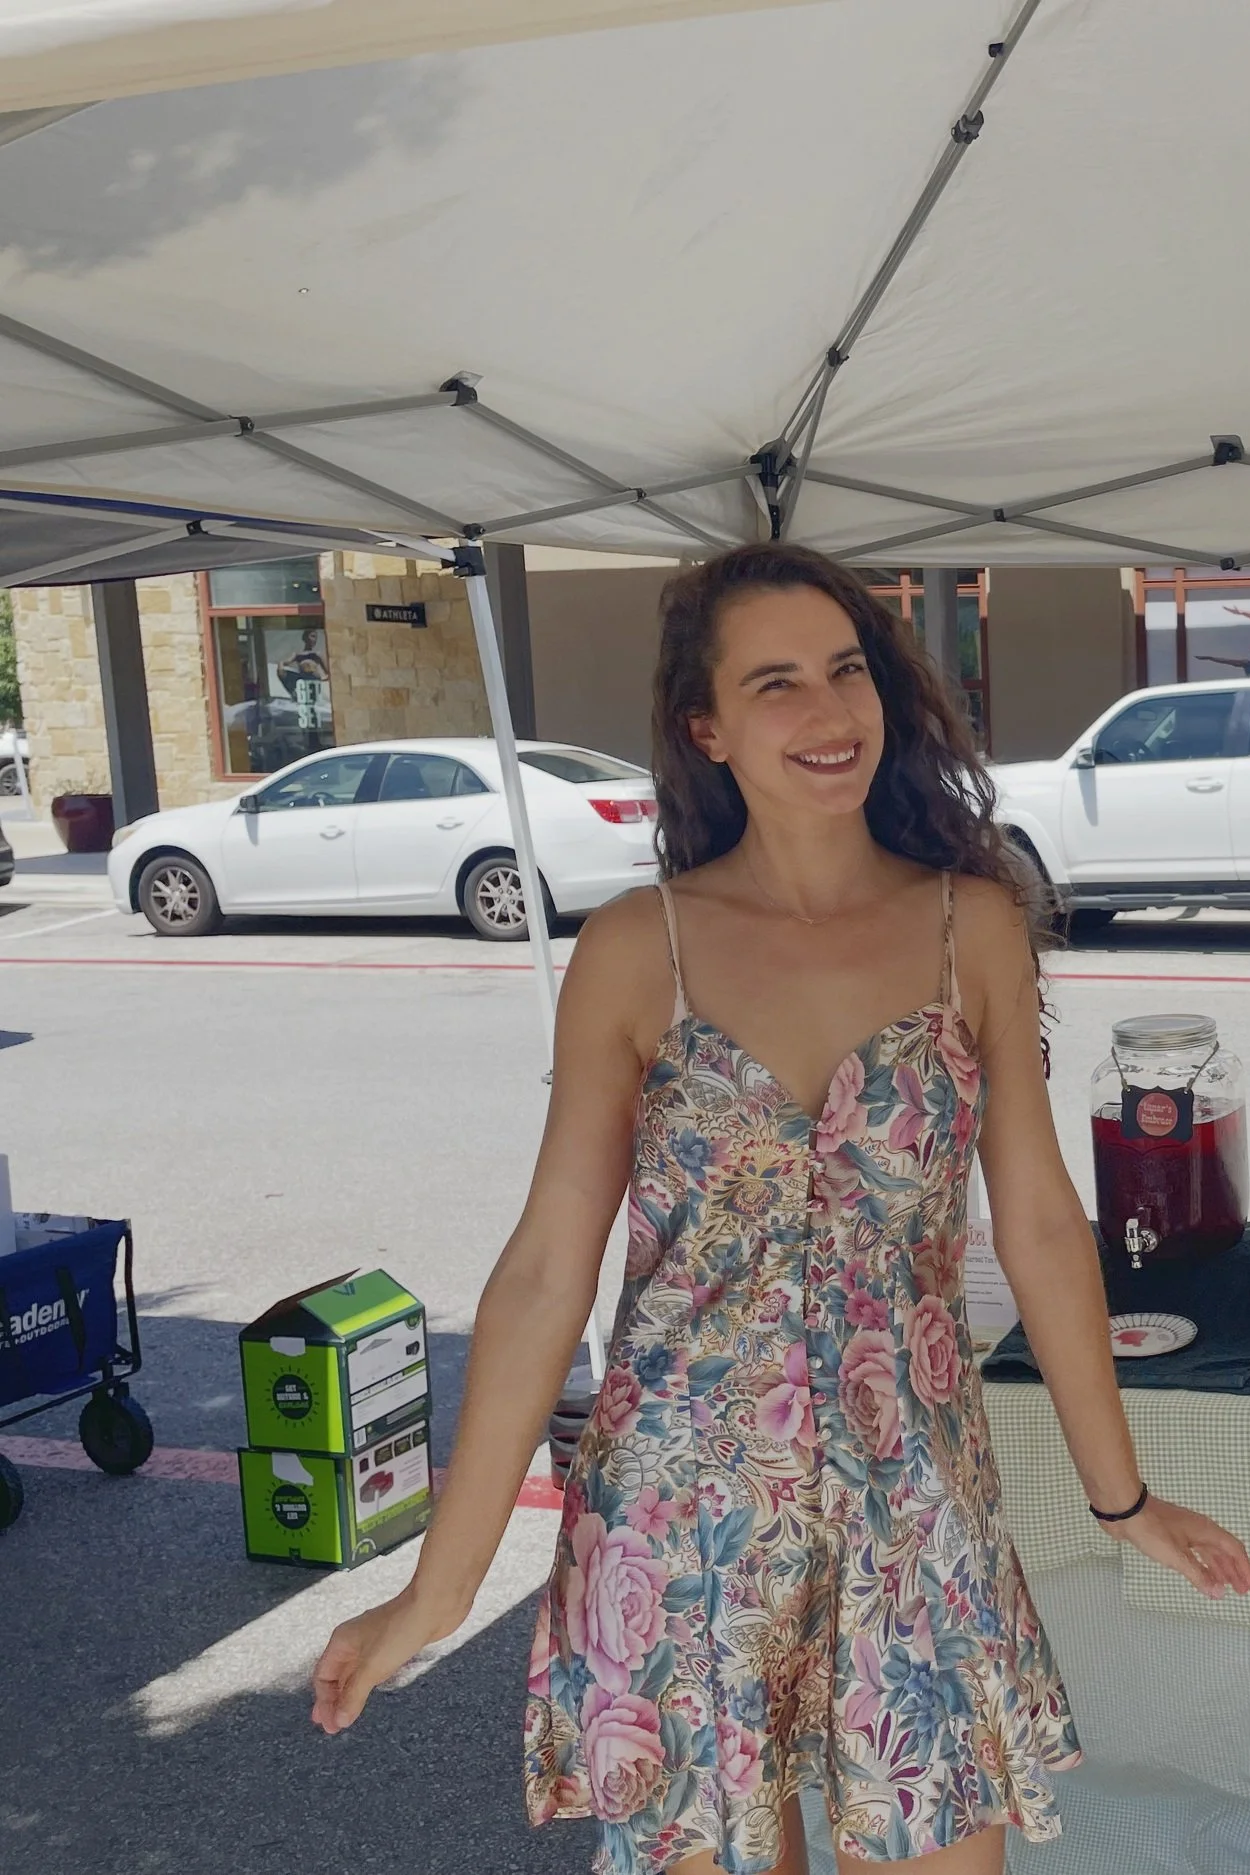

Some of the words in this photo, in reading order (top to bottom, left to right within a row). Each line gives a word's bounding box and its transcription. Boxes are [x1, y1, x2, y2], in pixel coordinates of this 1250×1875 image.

[382, 609, 418, 620] ATHLETA
[296, 679, 322, 704] GET
[298, 705, 321, 729] SET
